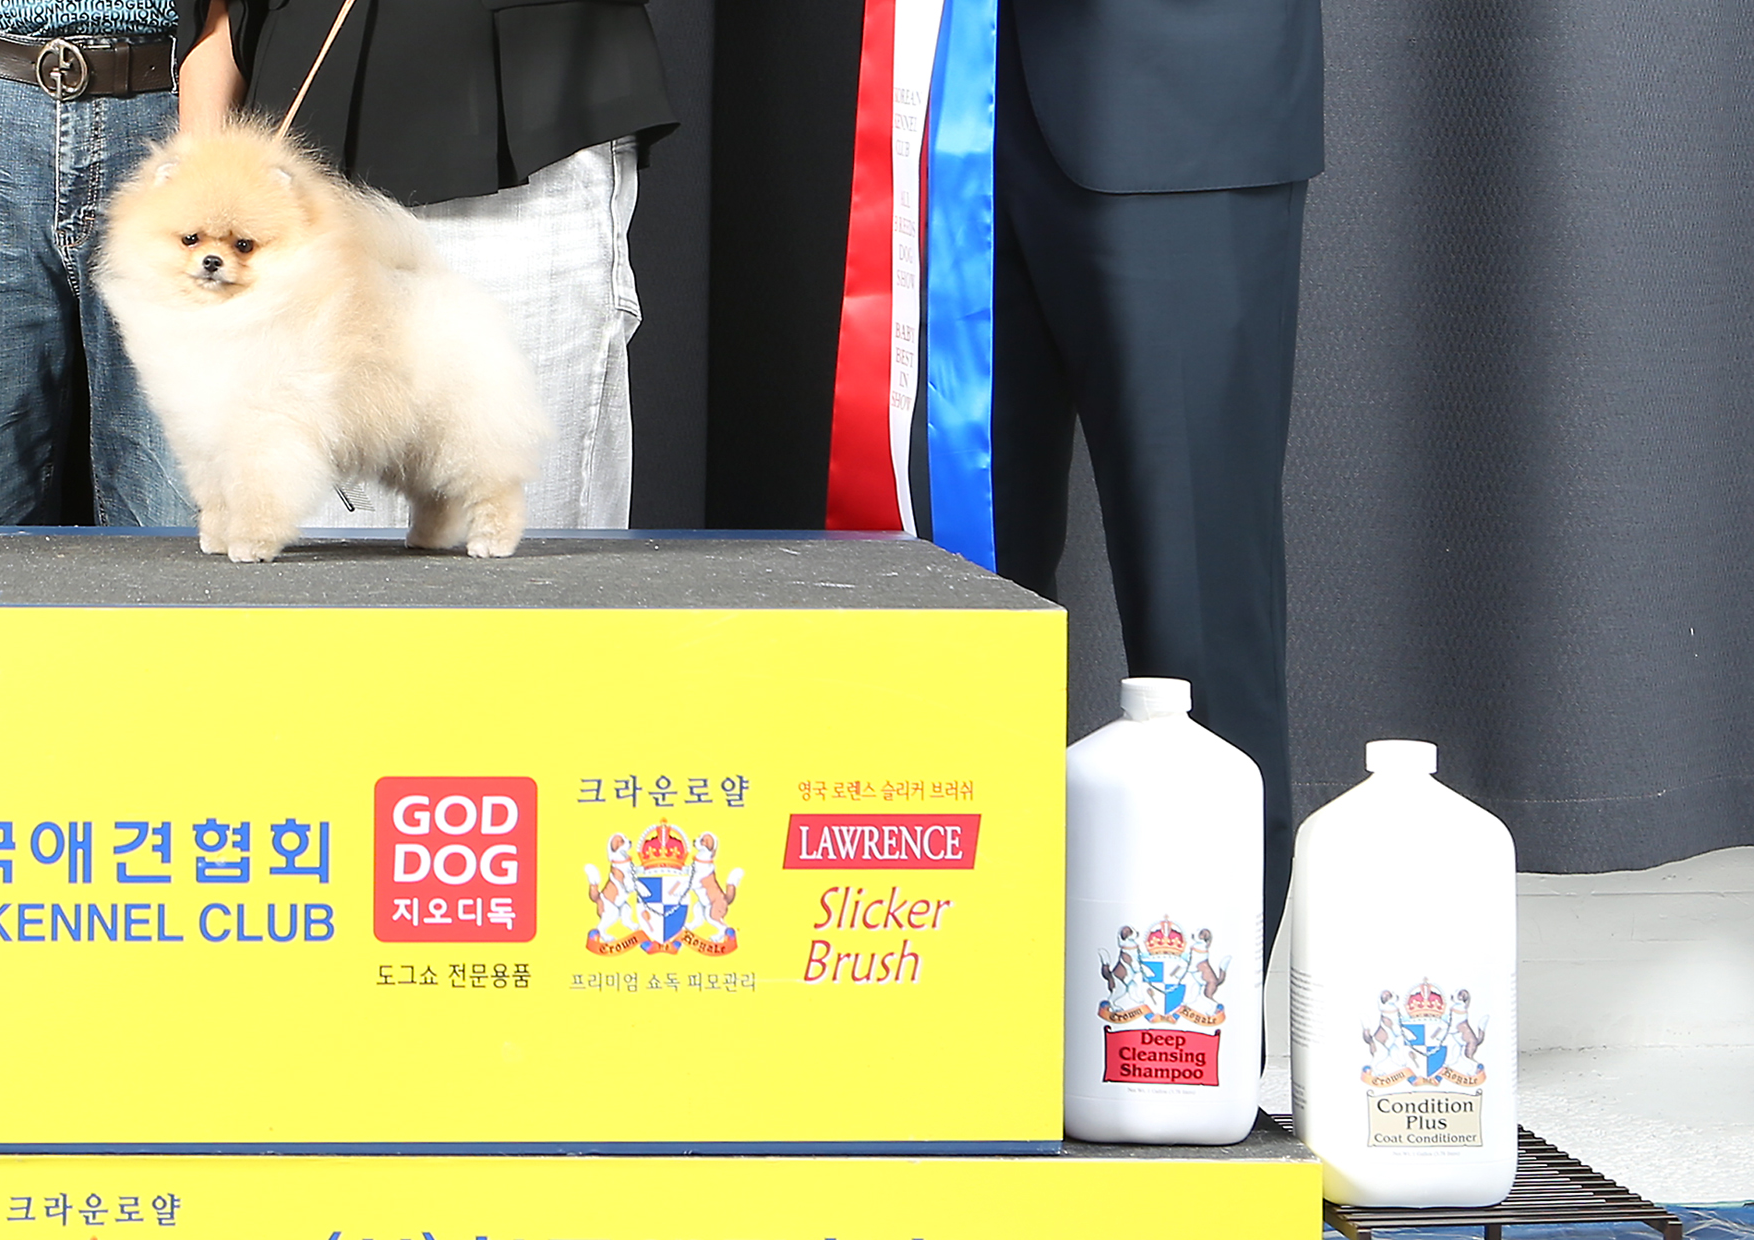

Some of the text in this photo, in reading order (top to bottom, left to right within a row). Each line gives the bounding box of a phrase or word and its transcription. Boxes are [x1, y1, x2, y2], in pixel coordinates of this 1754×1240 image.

[895, 322, 915, 342] BABY
[896, 347, 914, 368] BEST
[899, 371, 909, 388] IN
[891, 391, 912, 411] SHOW
[578, 775, 749, 808] 크라운로얄
[798, 780, 827, 801] 영국
[881, 780, 924, 801] 슬리커
[930, 780, 973, 801] 브러쉬
[393, 795, 519, 835] GOD
[799, 826, 963, 861] LAWRENCE
[394, 844, 518, 885] DOG
[392, 898, 516, 930] 지오디독
[814, 886, 954, 931] Slicker
[199, 903, 335, 943] CLUB
[802, 939, 923, 985] Brush
[376, 963, 531, 988] 도그쇼 전문용품
[570, 972, 757, 993] 프리미엄 쇼독 피모관리
[1141, 1033, 1186, 1049] Deep
[1119, 1047, 1206, 1066] Cleansing
[1120, 1064, 1204, 1081] Shampoo
[1377, 1098, 1474, 1113] Condition
[1407, 1116, 1447, 1130] Plus
[1374, 1133, 1476, 1143] Coat Conditioner
[7, 1193, 181, 1226] 크라운로얄
